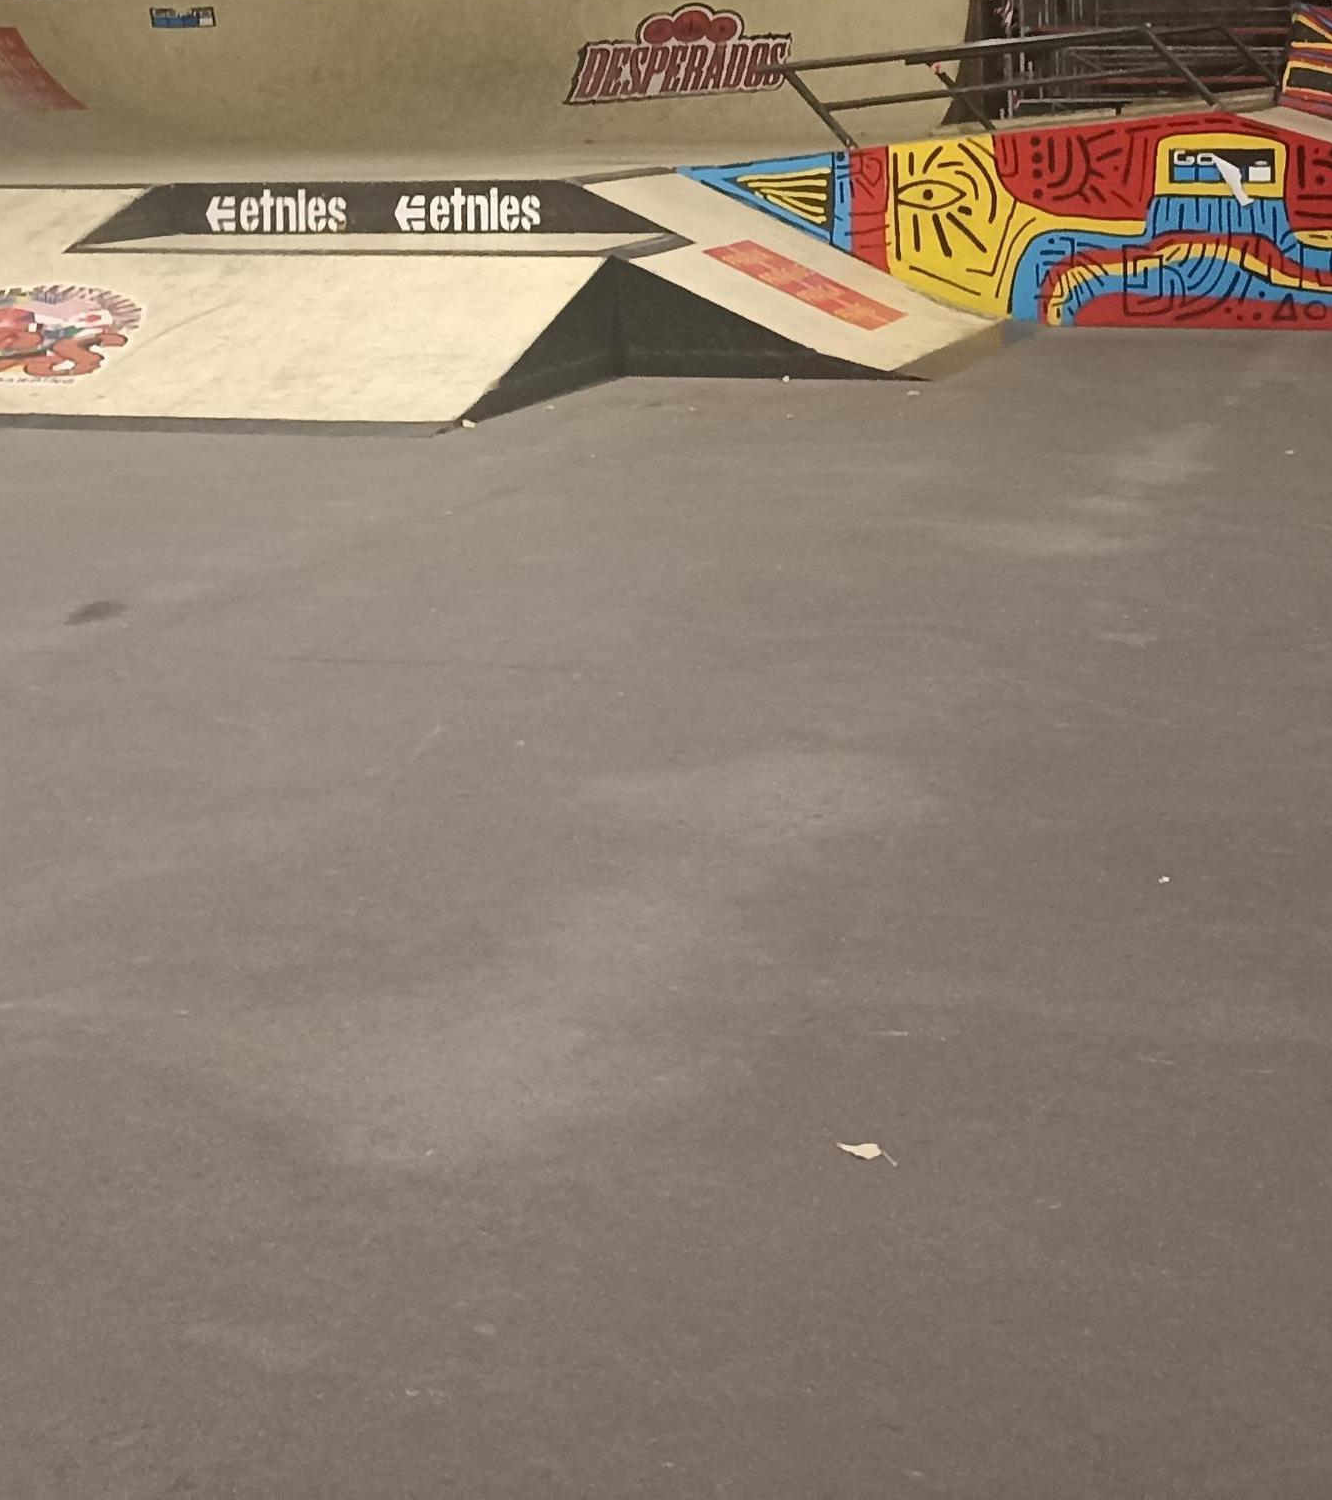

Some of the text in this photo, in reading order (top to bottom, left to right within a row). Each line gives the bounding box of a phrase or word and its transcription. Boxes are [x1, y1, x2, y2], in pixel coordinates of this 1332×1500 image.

[574, 42, 787, 99] DESPERADOS
[239, 186, 541, 232] etnies etnies
